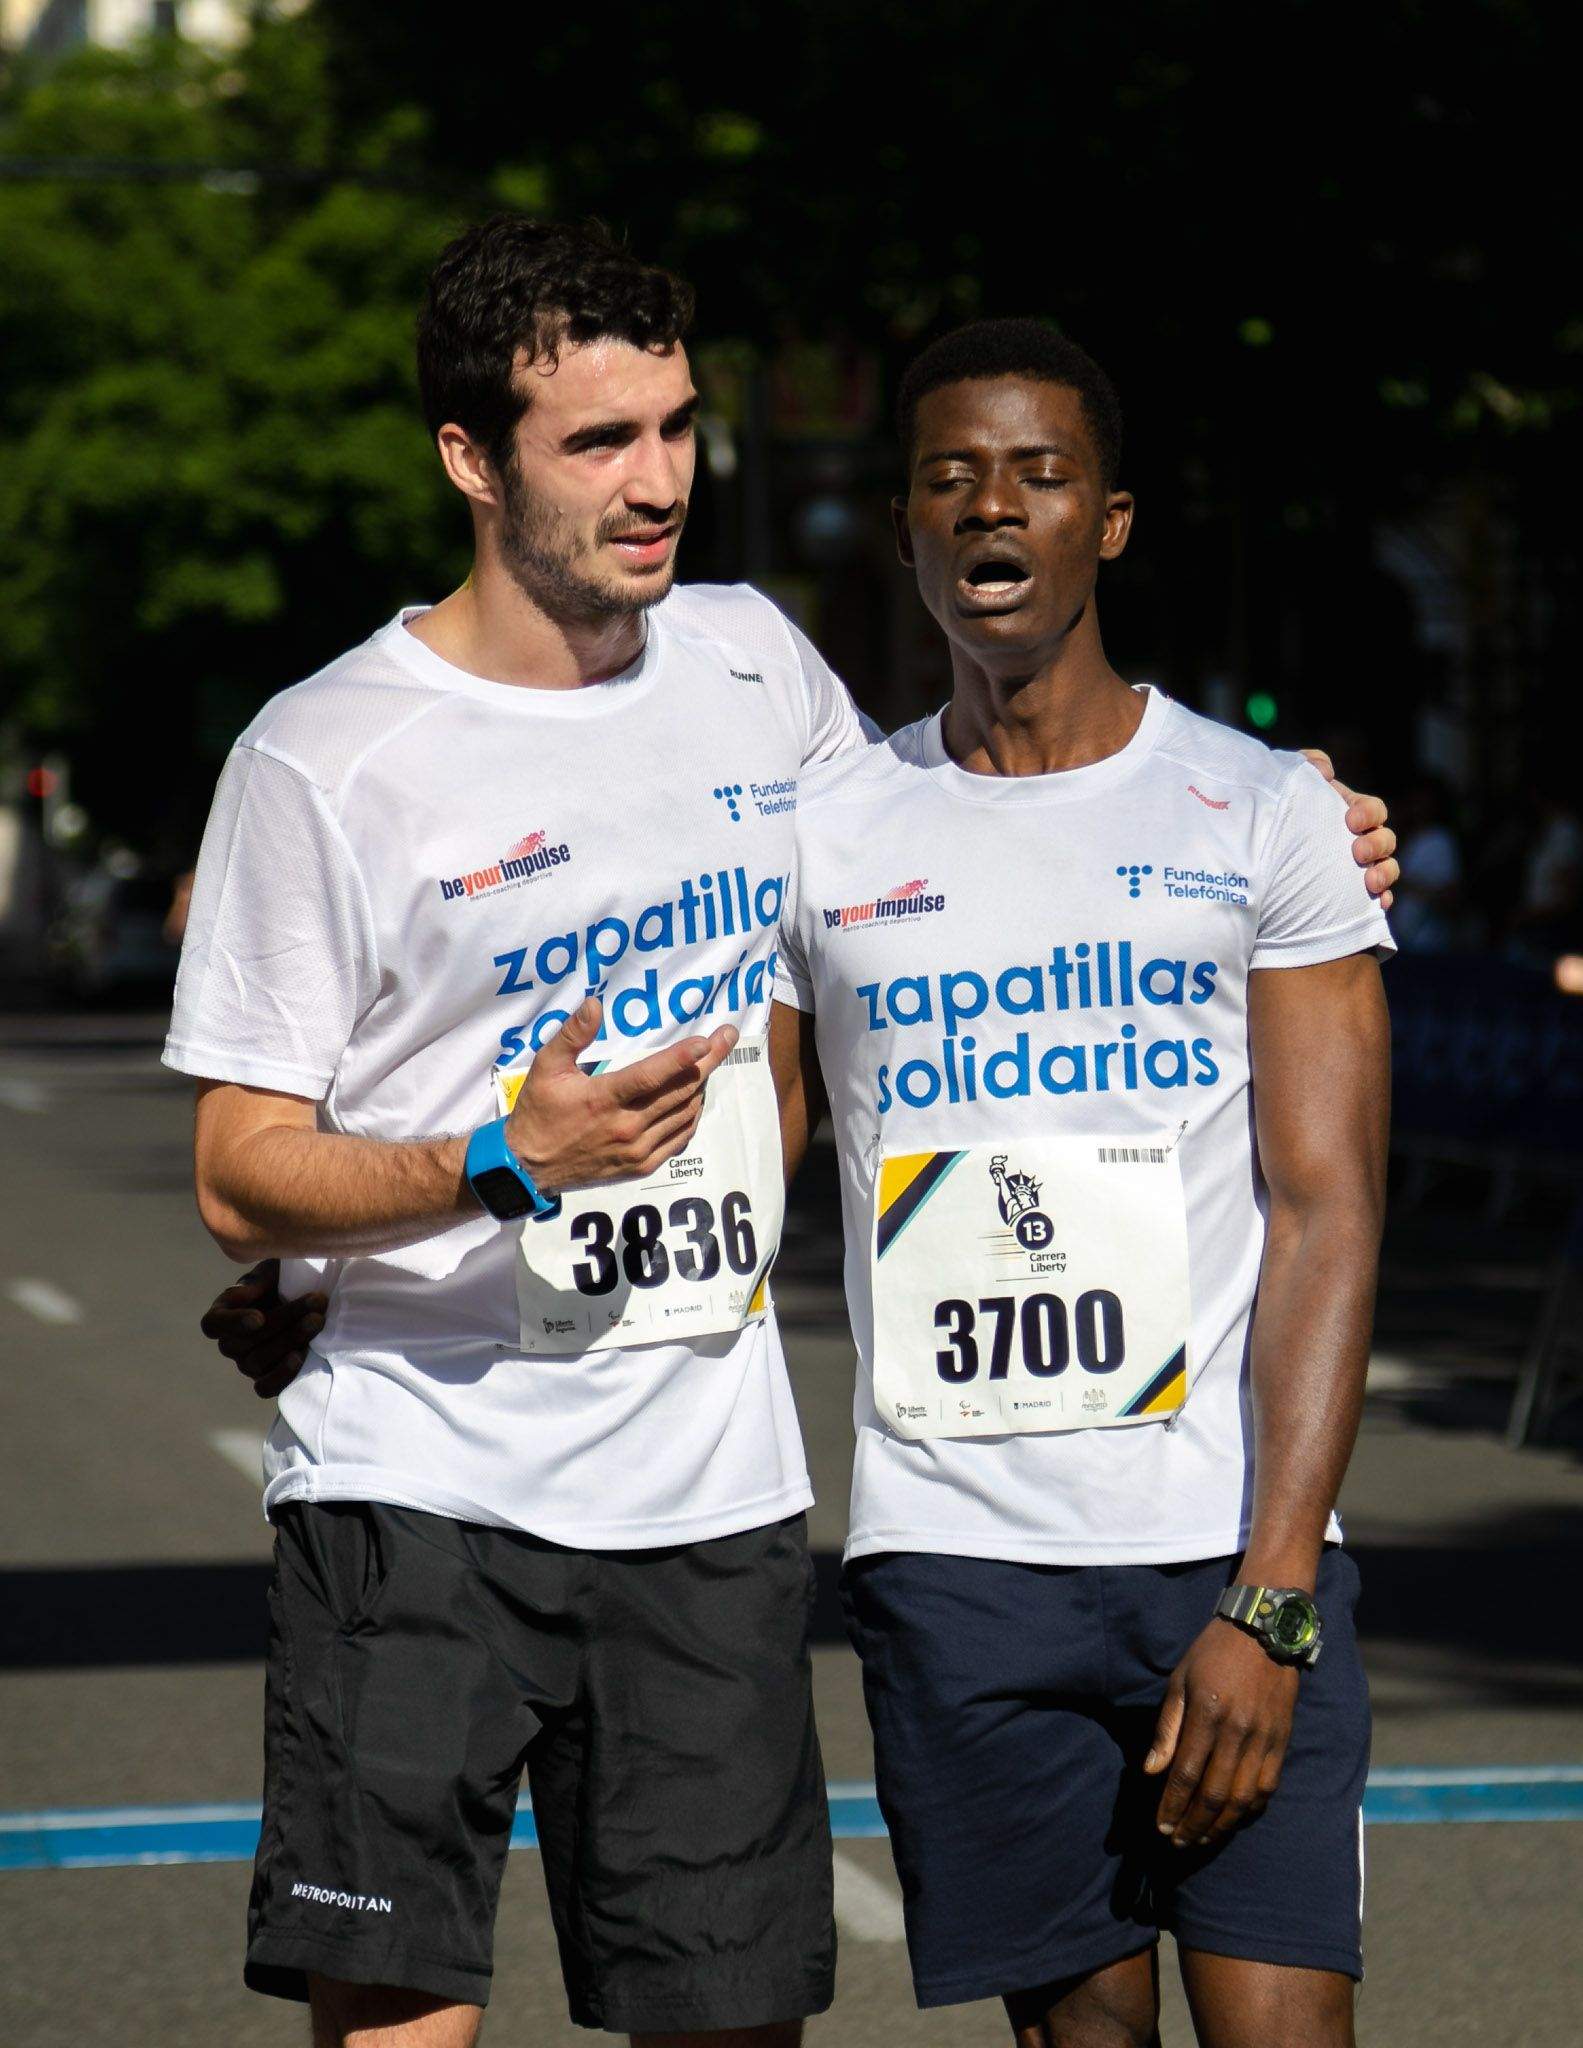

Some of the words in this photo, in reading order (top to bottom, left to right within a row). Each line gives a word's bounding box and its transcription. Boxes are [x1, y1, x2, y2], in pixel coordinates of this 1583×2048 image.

[440, 843, 571, 900] beyourimpulse
[1164, 867, 1248, 888] Fundación
[1164, 883, 1247, 905] Telefónica
[823, 894, 945, 929] beyourimpulse
[493, 866, 791, 996] zapatilla
[857, 941, 1218, 1037] zapatillas
[877, 1023, 1220, 1116] solidarias
[669, 1156, 703, 1168] Carrera
[669, 1167, 704, 1180] Liberty
[1022, 1221, 1047, 1241] 13
[570, 1190, 757, 1296] 3836
[1029, 1252, 1066, 1263] Carrera
[1030, 1262, 1067, 1273] Liberty
[673, 1304, 703, 1314] MADRID
[934, 1289, 1126, 1384] 3700
[1022, 1401, 1052, 1409] MADRID
[291, 1883, 392, 1913] METROPOLITAN
